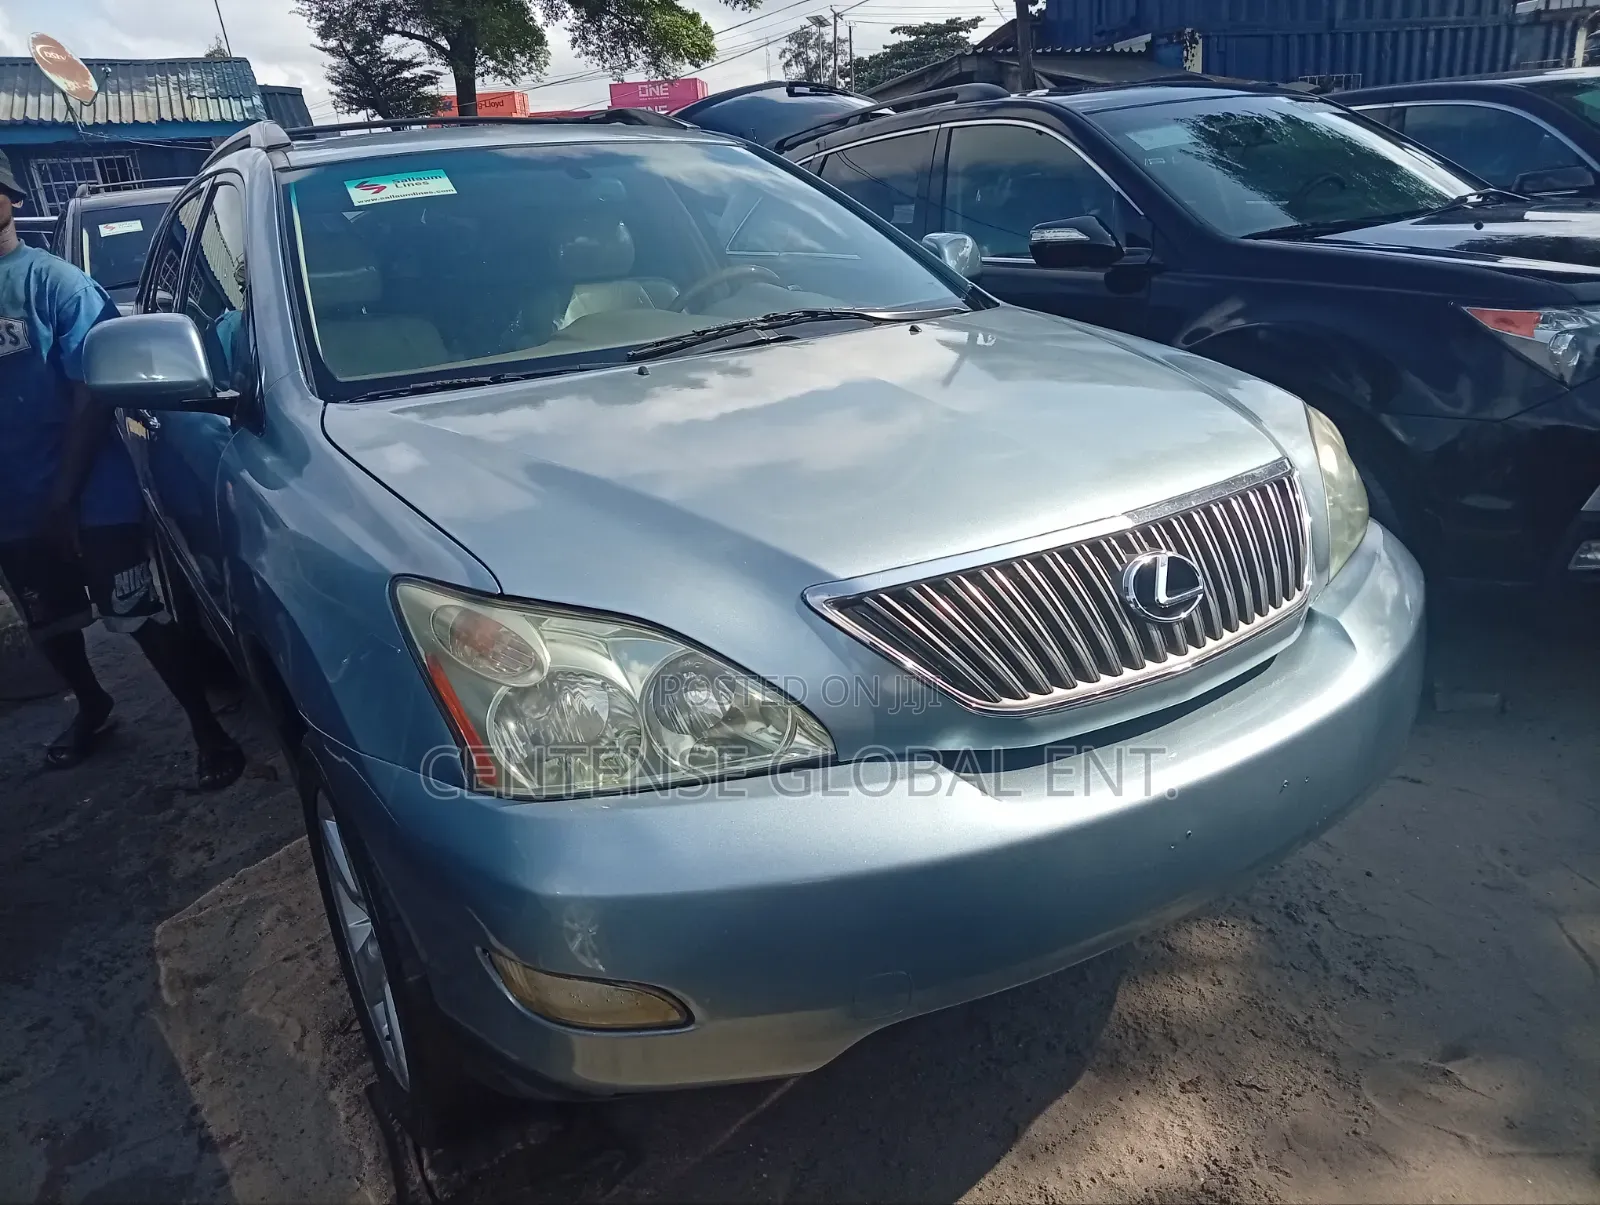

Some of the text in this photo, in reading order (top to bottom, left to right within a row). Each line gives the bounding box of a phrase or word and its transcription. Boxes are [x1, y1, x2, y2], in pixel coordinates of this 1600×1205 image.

[638, 83, 670, 97] ONE
[392, 175, 443, 184] Sallaum
[395, 180, 430, 189] Lines
